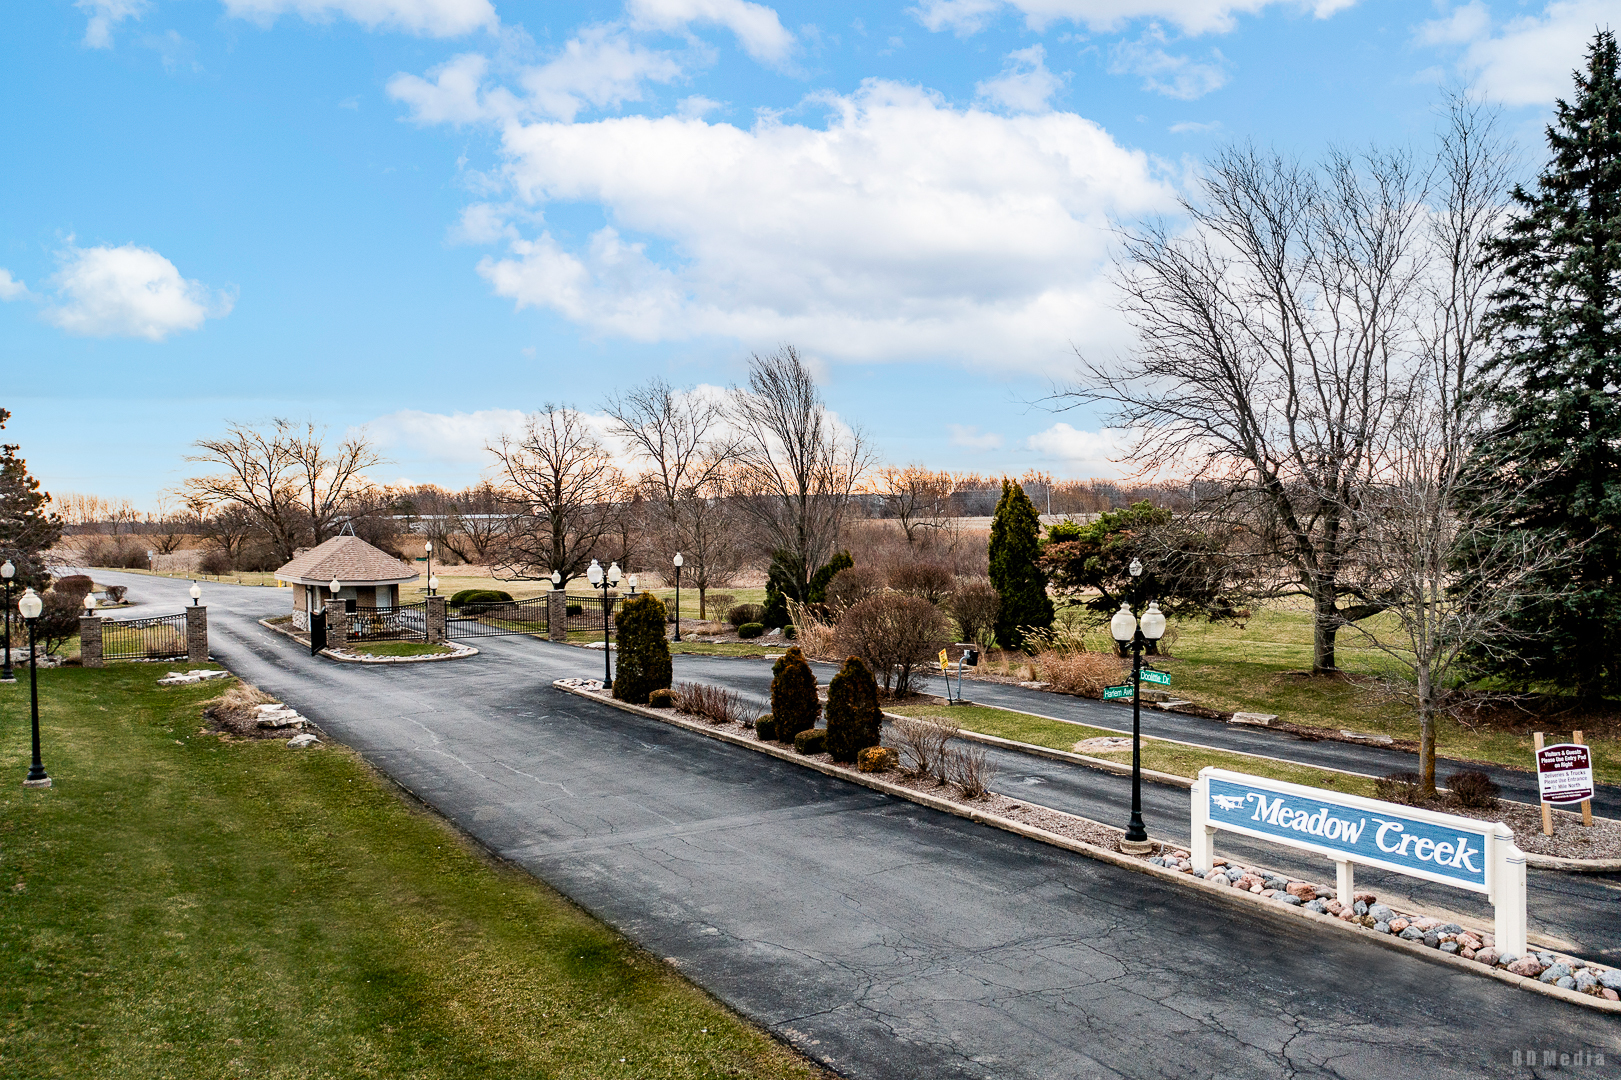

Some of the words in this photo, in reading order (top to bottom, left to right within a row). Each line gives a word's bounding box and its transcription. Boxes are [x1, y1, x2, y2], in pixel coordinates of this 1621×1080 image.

[1140, 672, 1161, 682] Doolittle
[1104, 690, 1122, 698] Harlem
[1123, 688, 1133, 696] Ave
[1246, 792, 1366, 845] Meadow
[1371, 818, 1481, 873] Creek
